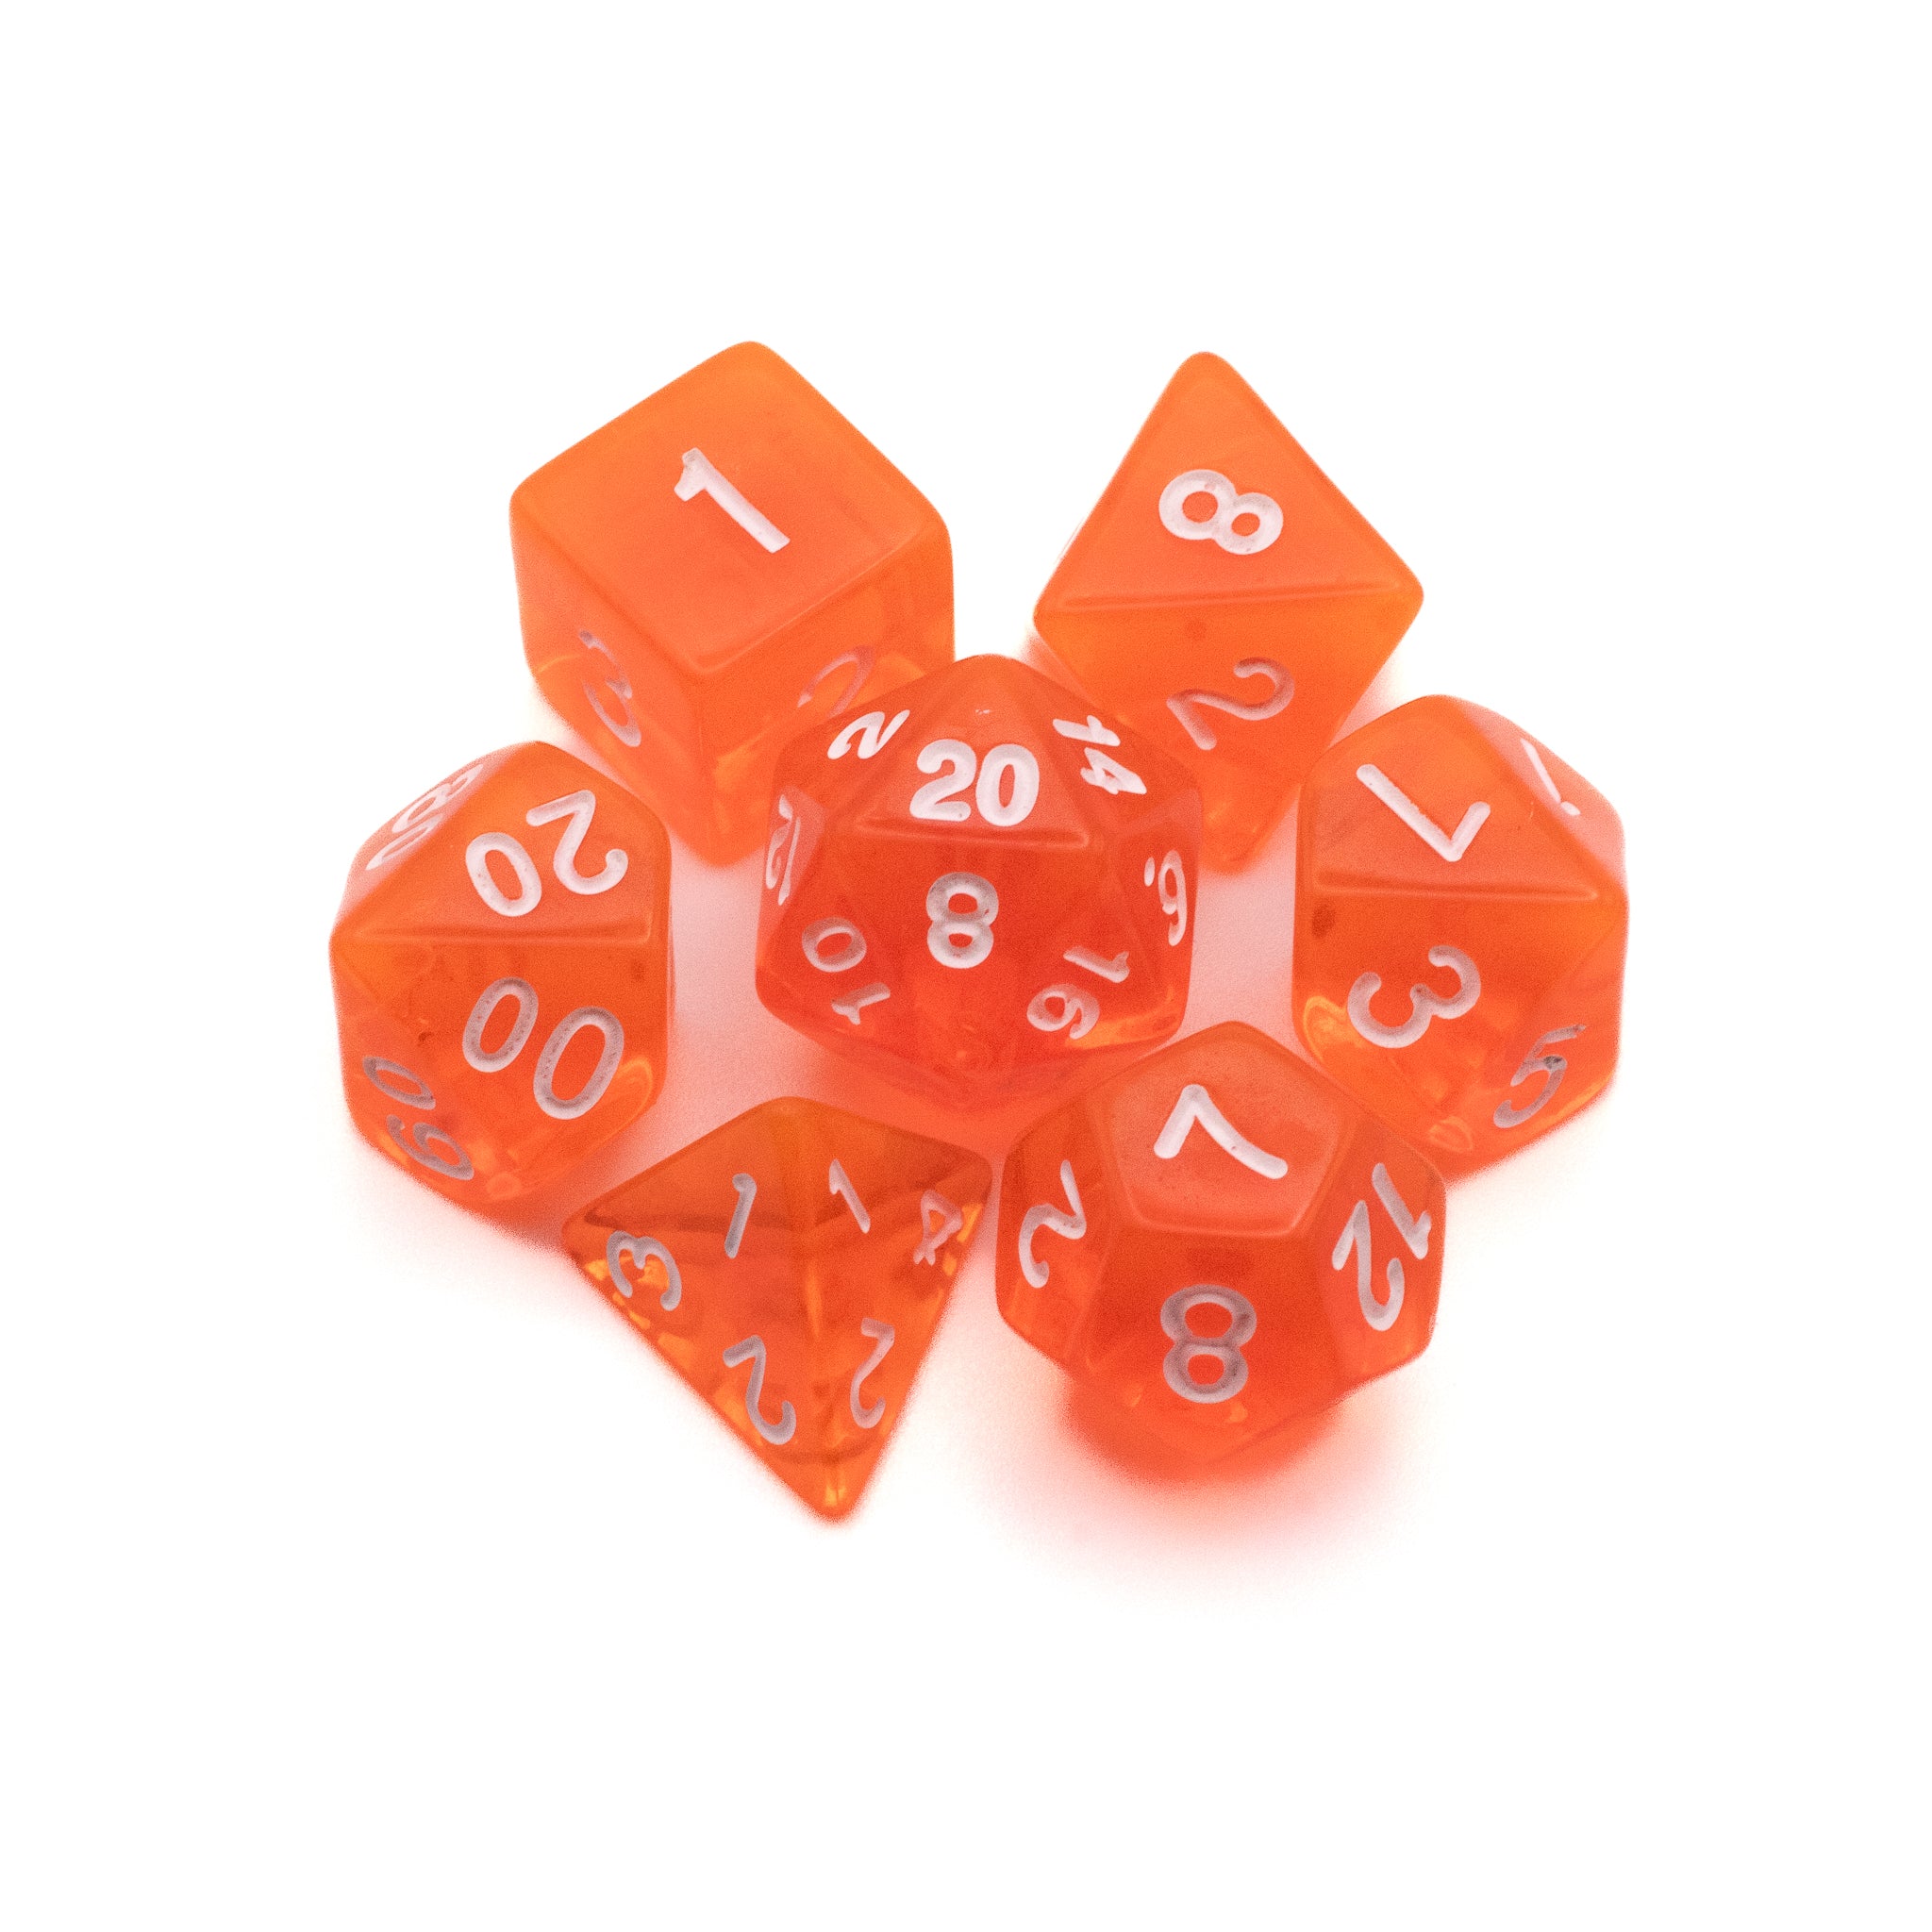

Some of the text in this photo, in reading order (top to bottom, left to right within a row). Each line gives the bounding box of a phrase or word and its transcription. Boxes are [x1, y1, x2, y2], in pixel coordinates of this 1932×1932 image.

[674, 447, 791, 553] 1
[1158, 468, 1284, 555] 8
[578, 629, 641, 747] 3
[827, 709, 910, 758] 2
[1166, 656, 1295, 750] 2
[908, 739, 1040, 826] 20
[1052, 715, 1147, 794] 14
[465, 789, 629, 917] 20
[766, 794, 801, 906] 12
[1356, 763, 1491, 862] 7
[801, 916, 891, 1024] 10
[925, 871, 999, 969] 8
[1026, 946, 1130, 1040] 16
[1347, 944, 1481, 1049] 3
[461, 976, 625, 1120] 00
[1493, 1024, 1587, 1128] 5
[1153, 1083, 1289, 1179] 7
[724, 1173, 758, 1258] 1
[828, 1158, 871, 1234] 1
[913, 1190, 963, 1266] 4
[1018, 1159, 1087, 1289] 2
[1331, 1162, 1432, 1331] 12
[606, 1229, 682, 1311] 3
[723, 1334, 797, 1445] 2
[850, 1317, 895, 1428] 2
[1159, 1283, 1258, 1404] 8
